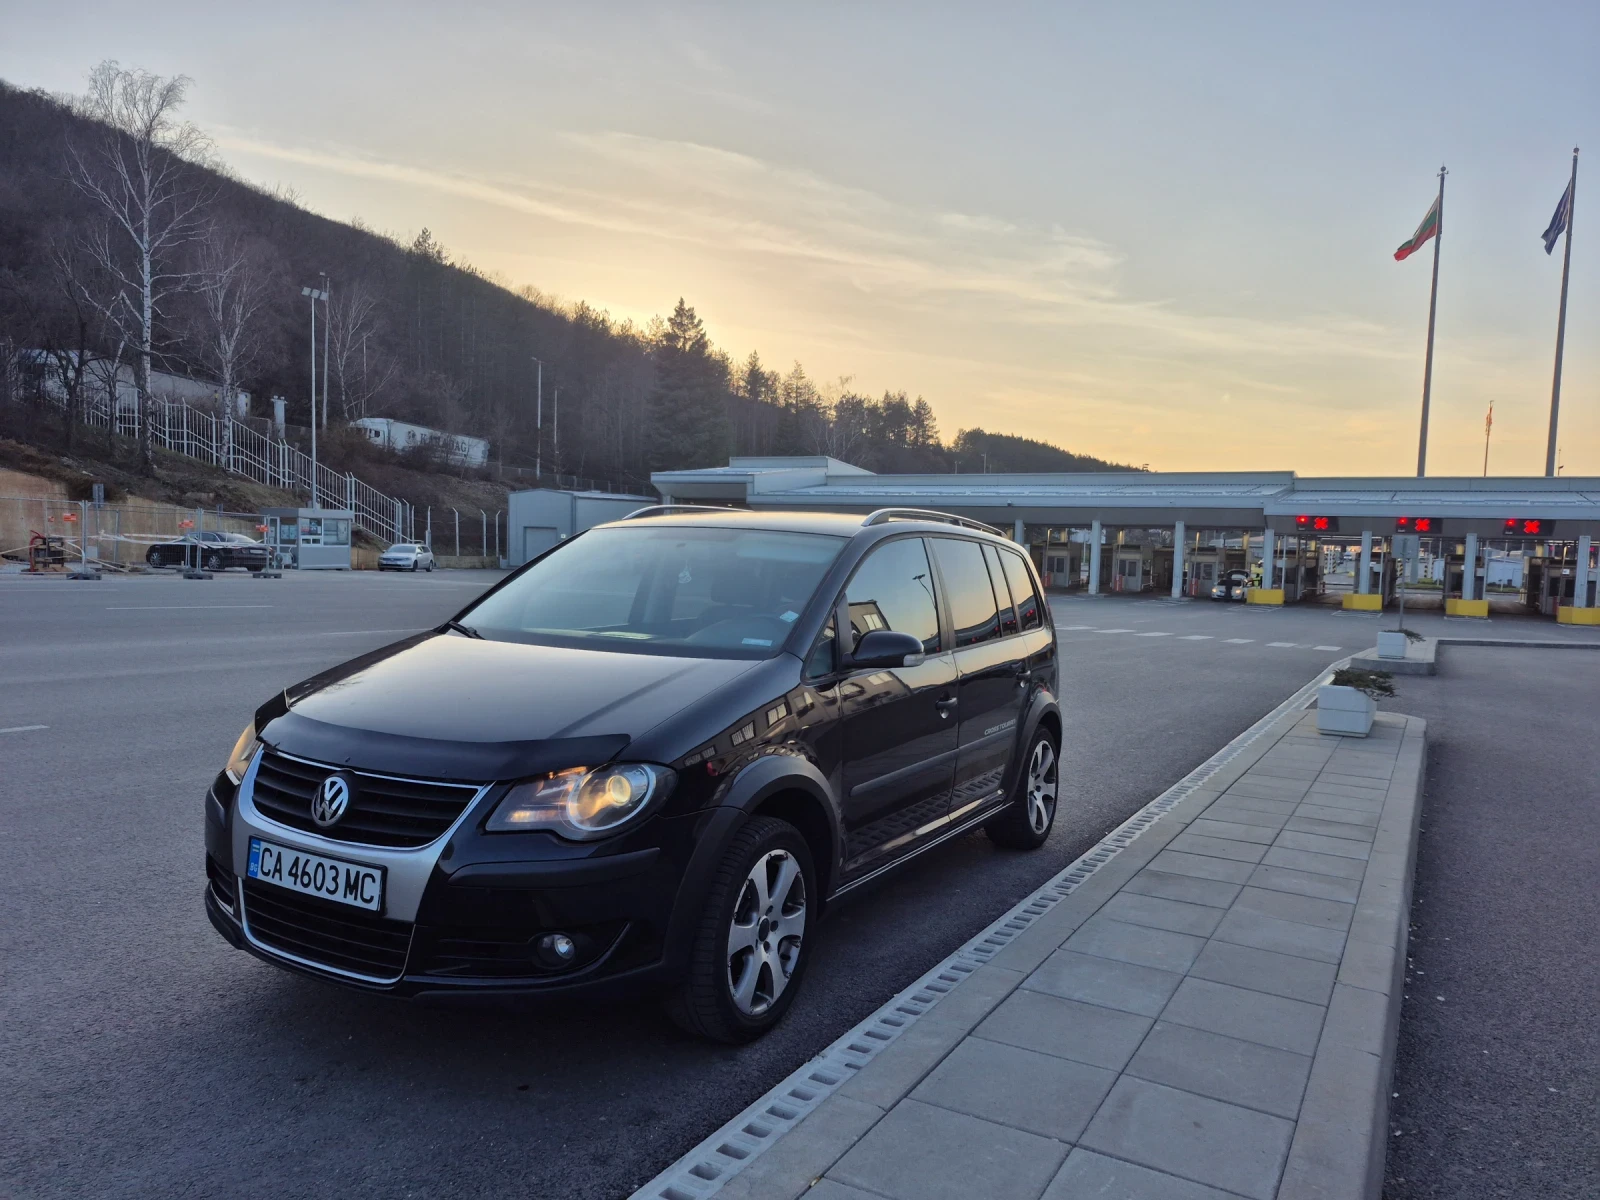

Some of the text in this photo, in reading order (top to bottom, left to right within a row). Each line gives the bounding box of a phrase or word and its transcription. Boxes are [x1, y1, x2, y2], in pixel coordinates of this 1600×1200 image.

[249, 862, 259, 872] BG
[260, 847, 376, 904] CA 4603 MC
